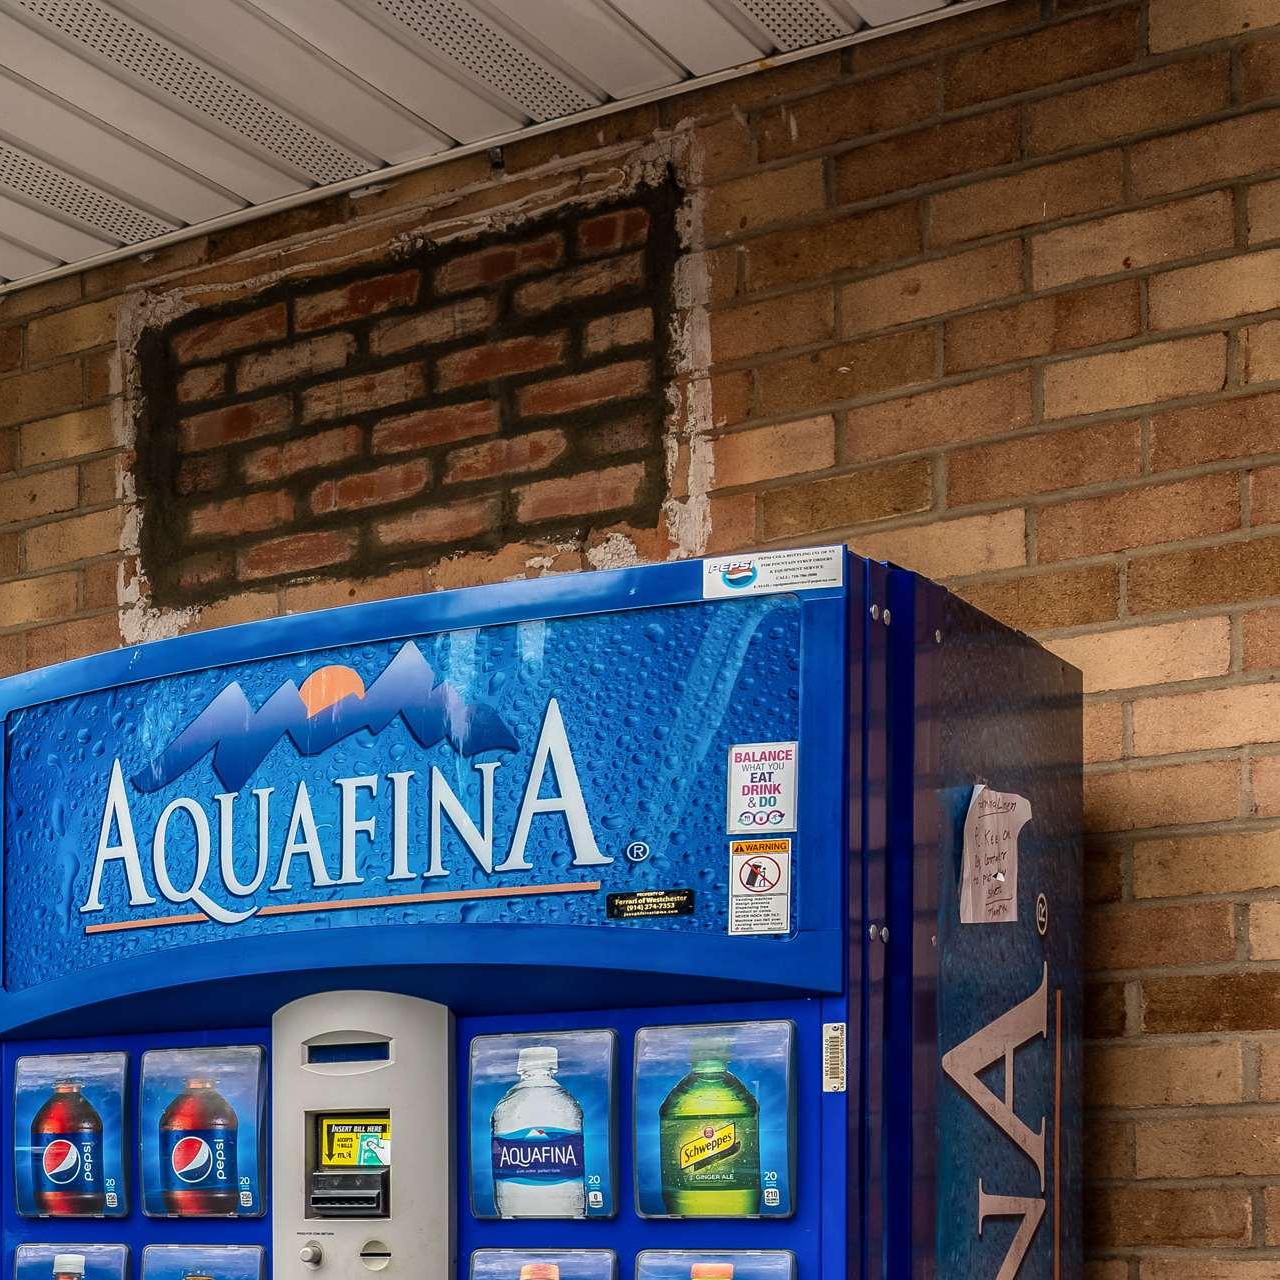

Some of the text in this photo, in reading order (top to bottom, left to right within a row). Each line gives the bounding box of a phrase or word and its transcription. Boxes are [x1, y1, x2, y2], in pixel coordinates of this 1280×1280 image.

[708, 560, 754, 574] PEPSI
[734, 749, 793, 763] BALANCE
[768, 762, 784, 770] YOU
[750, 772, 774, 783] EAT
[742, 784, 782, 796] DRINK
[747, 796, 777, 808] & DO
[79, 697, 614, 924] AQUAFINA
[745, 842, 787, 852] WARNING
[684, 1133, 732, 1163] Schweppes
[81, 1142, 94, 1181] pepsi
[213, 1139, 227, 1180] pepsi
[499, 1144, 577, 1167] AQUAFINA
[764, 1171, 778, 1181] 20
